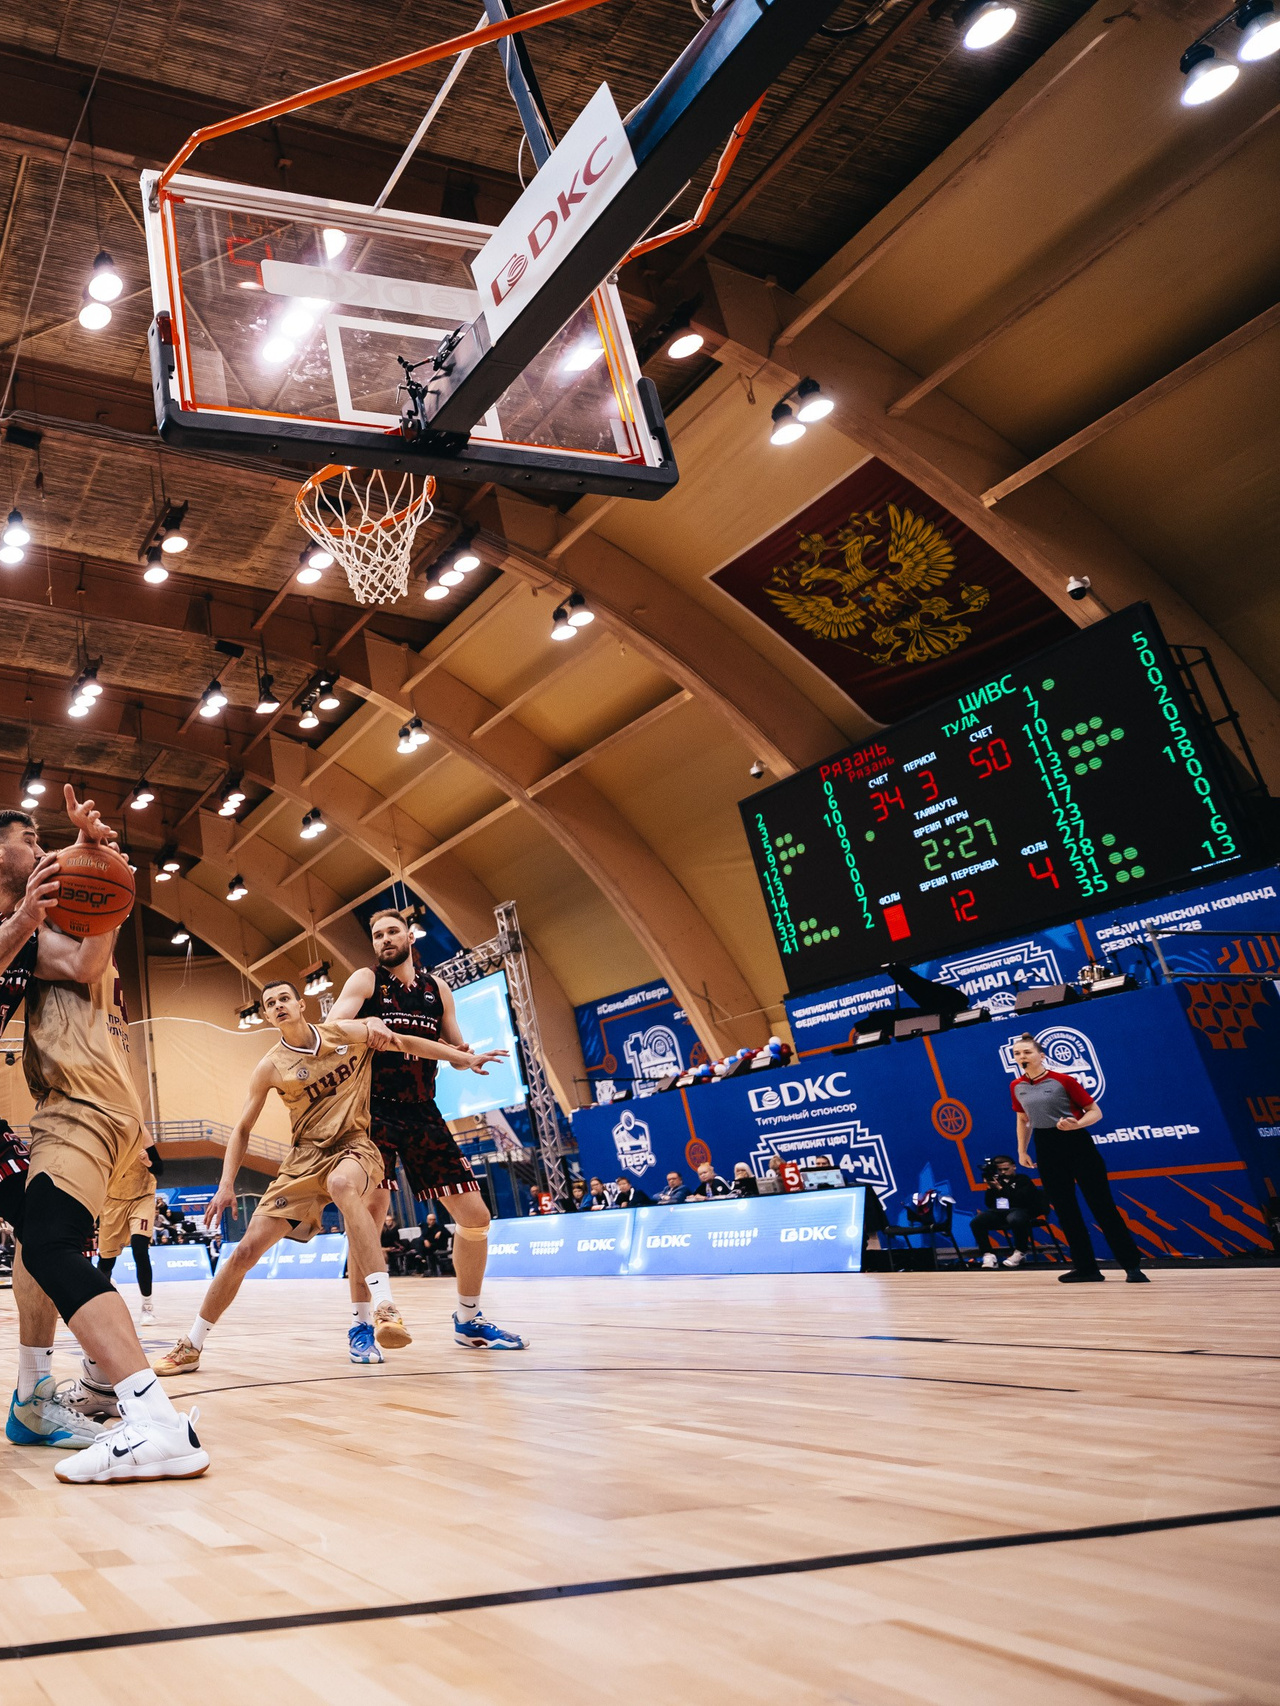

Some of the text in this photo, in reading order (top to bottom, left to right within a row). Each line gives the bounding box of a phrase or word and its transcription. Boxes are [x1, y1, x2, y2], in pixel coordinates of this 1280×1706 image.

[528, 135, 613, 260] DKC
[1132, 631, 1148, 650] 5
[1140, 650, 1155, 667] 0
[1148, 667, 1162, 684] 0
[958, 673, 1017, 714] ЦИВС
[1022, 685, 1033, 701] 1
[1154, 685, 1172, 704] 2
[1027, 701, 1038, 718] 7
[1162, 703, 1178, 720] 0
[941, 713, 980, 738] ТУЛА
[969, 725, 993, 743] СЧЕТ
[1022, 718, 1048, 739] 10
[1170, 720, 1186, 740] 5
[1028, 735, 1052, 756] 11
[1162, 740, 1195, 763] 18
[903, 751, 937, 773] ПЕРИОД
[969, 738, 1012, 779] 50
[1034, 751, 1061, 774] 13
[1186, 758, 1202, 776] 0
[824, 781, 833, 795] 0
[868, 772, 889, 789] СЧЕТ
[918, 770, 939, 801] 3
[1041, 768, 1068, 790] 15
[1194, 777, 1210, 796] 0
[828, 795, 838, 810] 6
[870, 786, 905, 822] 34
[1047, 785, 1071, 806] 17
[1202, 796, 1216, 814] 1
[913, 796, 959, 820] ТАЙМАУТЫ
[1052, 803, 1081, 826] 23
[756, 814, 765, 828] 2
[824, 810, 842, 828] 10
[913, 810, 969, 839] ВРЕМЯ ИГРЫ
[1210, 814, 1228, 834] 6
[759, 827, 769, 841] 3
[836, 824, 846, 838] 0
[1058, 820, 1084, 844] 27
[763, 840, 772, 854] 5
[841, 838, 851, 854] 9
[921, 818, 998, 872] 2:27
[1020, 840, 1049, 856] ФОЛЫ
[1065, 838, 1094, 862] 28
[1201, 835, 1236, 858] 13
[767, 854, 776, 868] 9
[846, 853, 856, 868] 0
[1072, 856, 1099, 879] 31
[764, 868, 781, 884] 12
[850, 868, 860, 882] 0
[919, 858, 999, 892] ВРЕМЯ ПЕРЕРЫВА
[1028, 856, 1060, 889] 4
[768, 882, 784, 898] 13
[854, 882, 864, 898] 0
[1078, 874, 1108, 897] 35
[772, 895, 789, 912] 14
[858, 897, 868, 912] 7
[878, 891, 901, 906] ФОЛЫ
[950, 889, 979, 922] 12
[774, 910, 792, 927] 21
[863, 913, 874, 929] 2
[1096, 885, 1277, 941] СРЕДИ МУЖСКИХ КОМАНД
[778, 923, 797, 941] 33
[783, 938, 799, 954] 41
[1100, 935, 1143, 954] СЕЗОН
[957, 954, 1022, 977] ЧЕМПИОНАТ ЦФО
[958, 970, 1012, 998] ИНАЛ
[792, 984, 905, 1018] ЧЕМПИОНАТ ЦЕНТРАЛЬНОГ
[795, 997, 892, 1029] ФЕДЕРАЛЬНОГО ОКРУГА
[779, 1071, 852, 1107] DKC
[755, 1102, 858, 1127] Титульный спонсор
[777, 1134, 848, 1153] ЧЕМПИОНАТ ЦФО
[1091, 1123, 1201, 1146] ьяБКТверь
[618, 1153, 656, 1169] ТВЕРЬ
[784, 1167, 800, 1186] 5
[541, 1196, 551, 1211] 5
[661, 1234, 692, 1248] DKC
[798, 1225, 838, 1242] DKC
[589, 1238, 616, 1251] DKC
